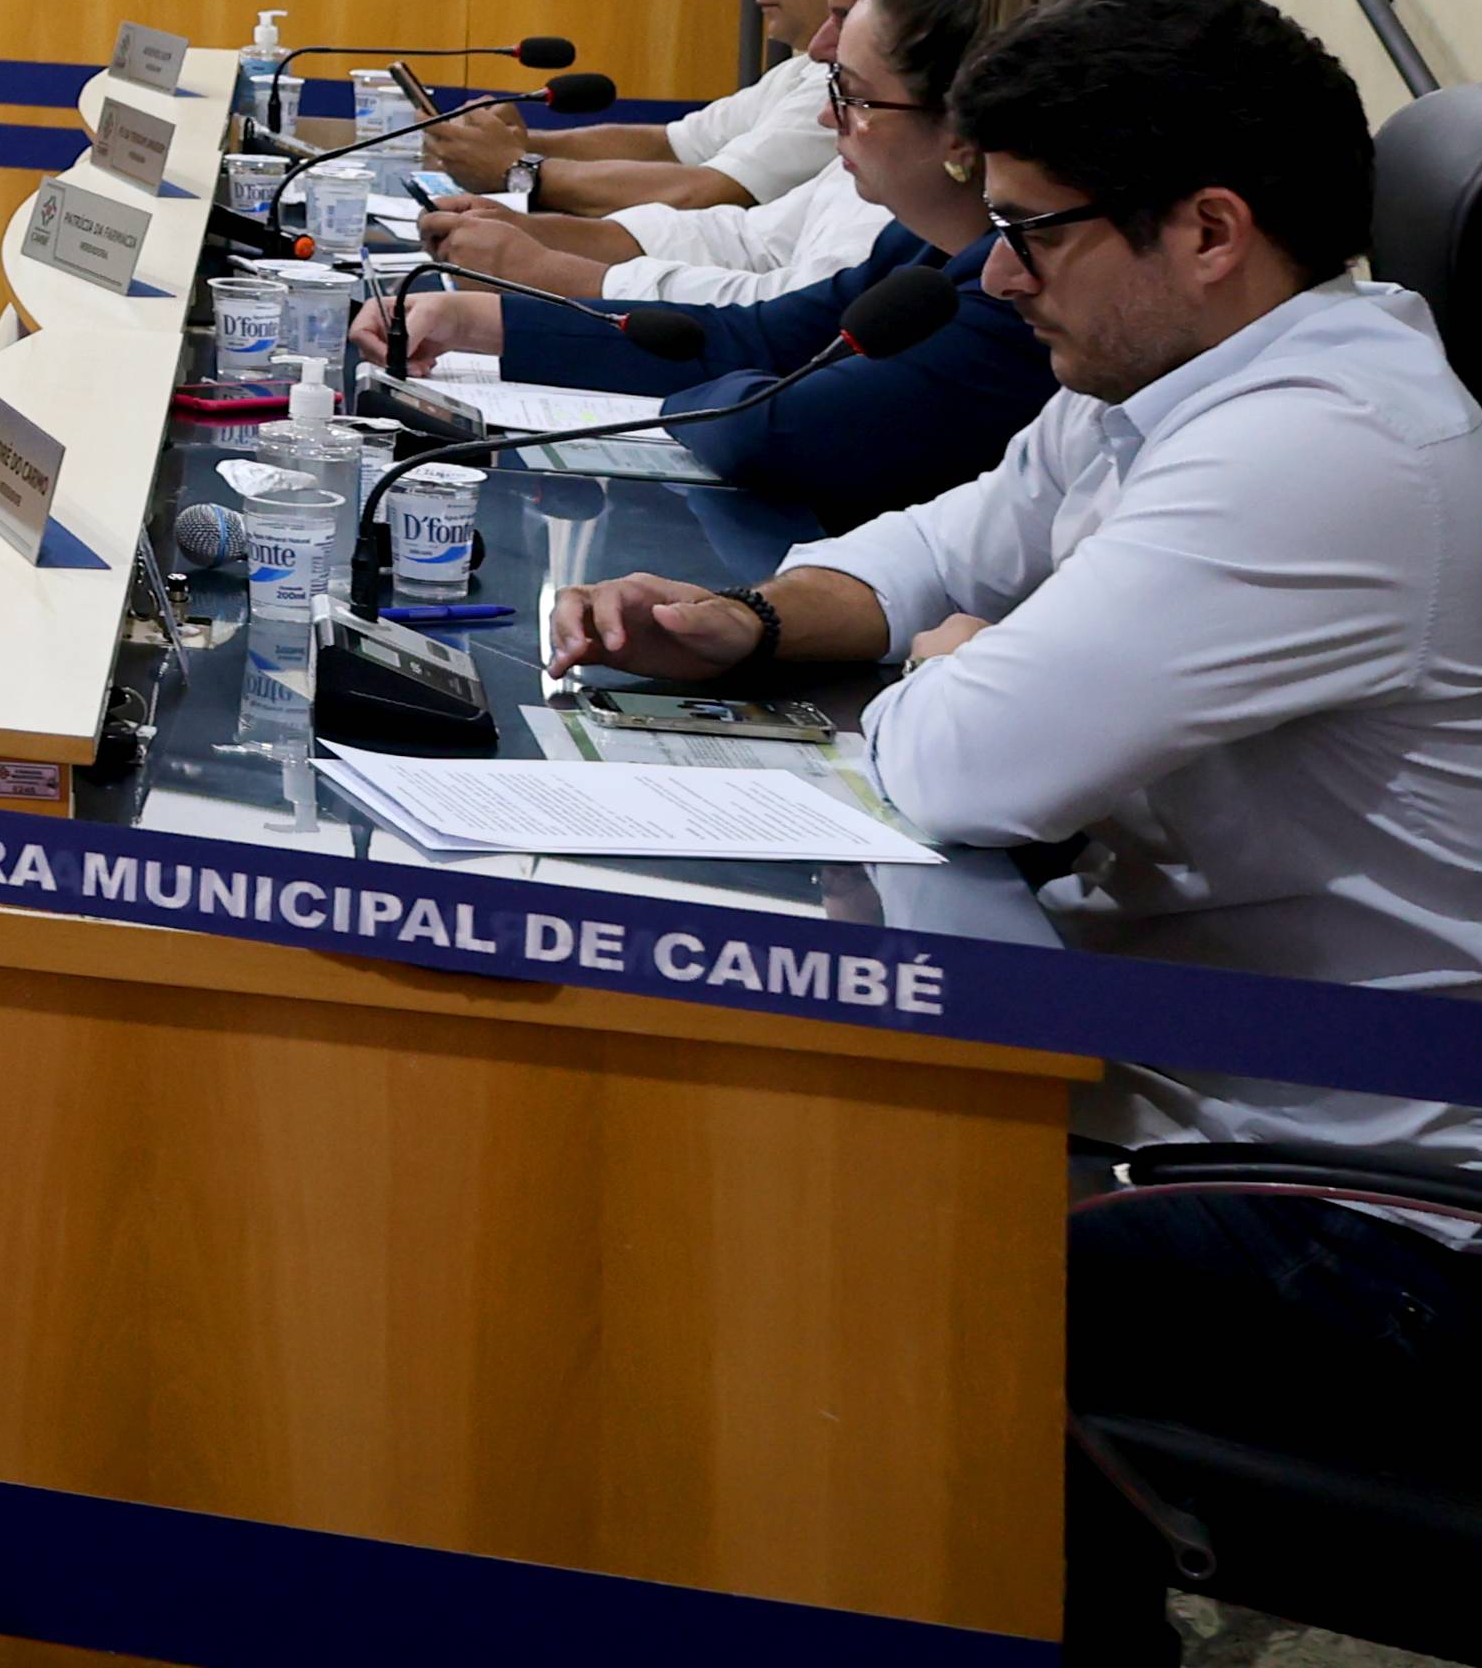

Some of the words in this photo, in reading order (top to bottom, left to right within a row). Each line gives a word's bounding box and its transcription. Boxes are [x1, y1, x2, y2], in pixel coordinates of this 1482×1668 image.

[276, 590, 306, 600] 200ml
[81, 851, 497, 955] MUNICIPAL
[524, 912, 626, 972] DE
[653, 932, 944, 1015] CAMBÉ
